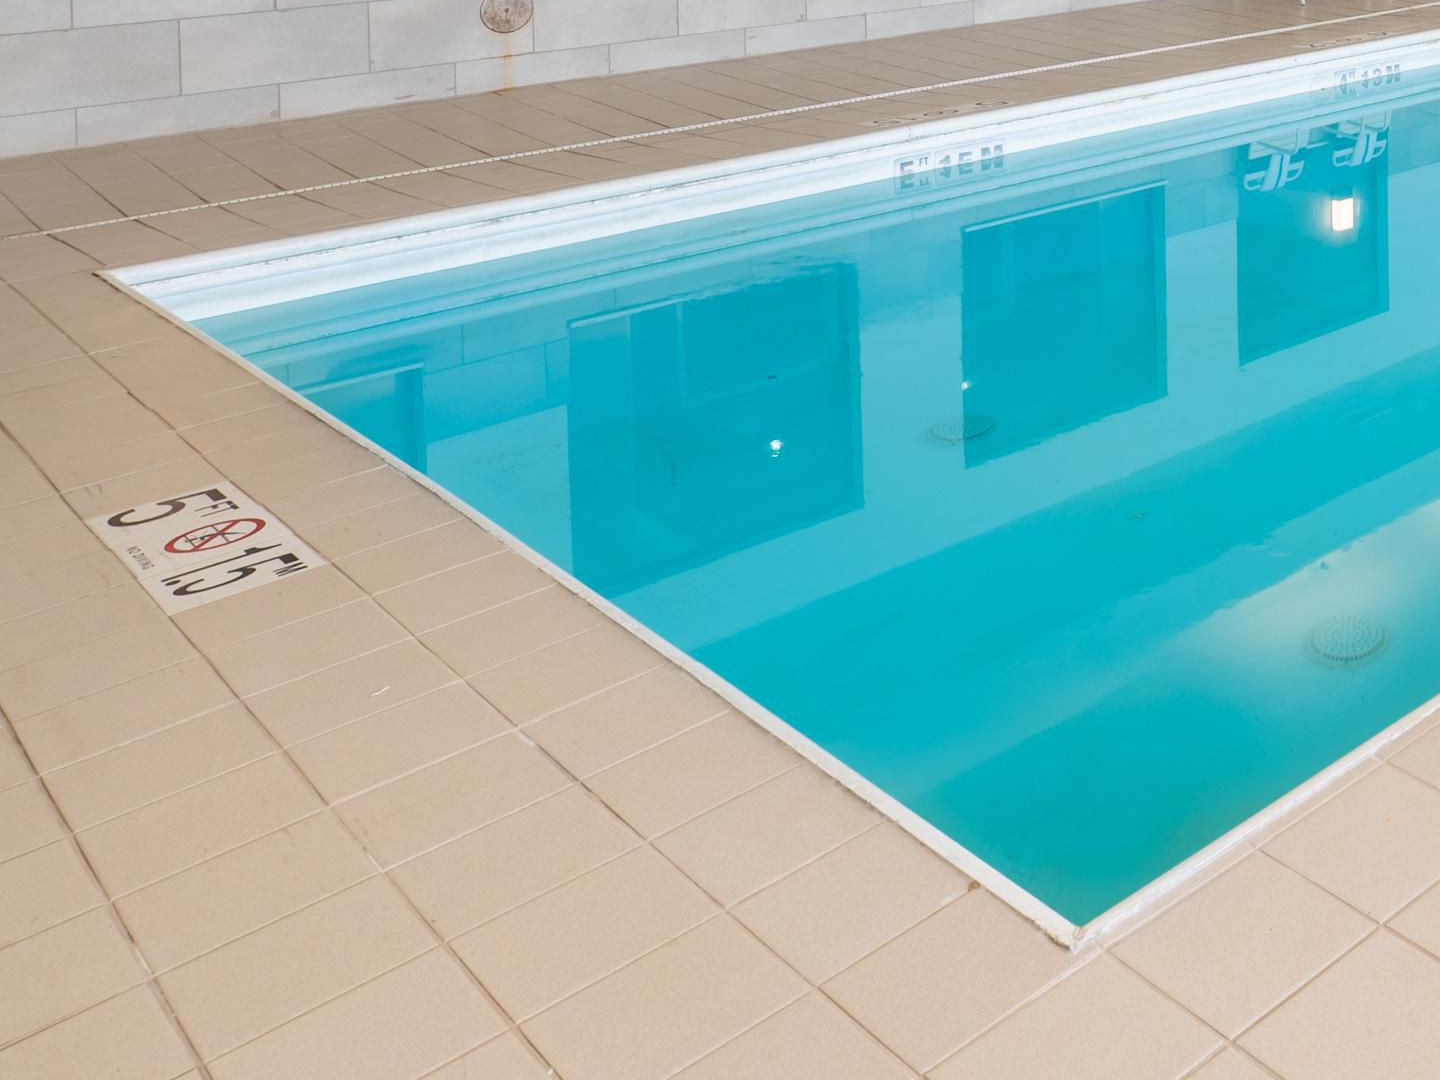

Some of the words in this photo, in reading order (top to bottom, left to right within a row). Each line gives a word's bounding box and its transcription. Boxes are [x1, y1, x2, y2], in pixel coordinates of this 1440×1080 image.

[107, 487, 228, 528] 5
[194, 500, 240, 518] FT
[161, 542, 300, 597] 1.5
[272, 561, 308, 577] M
